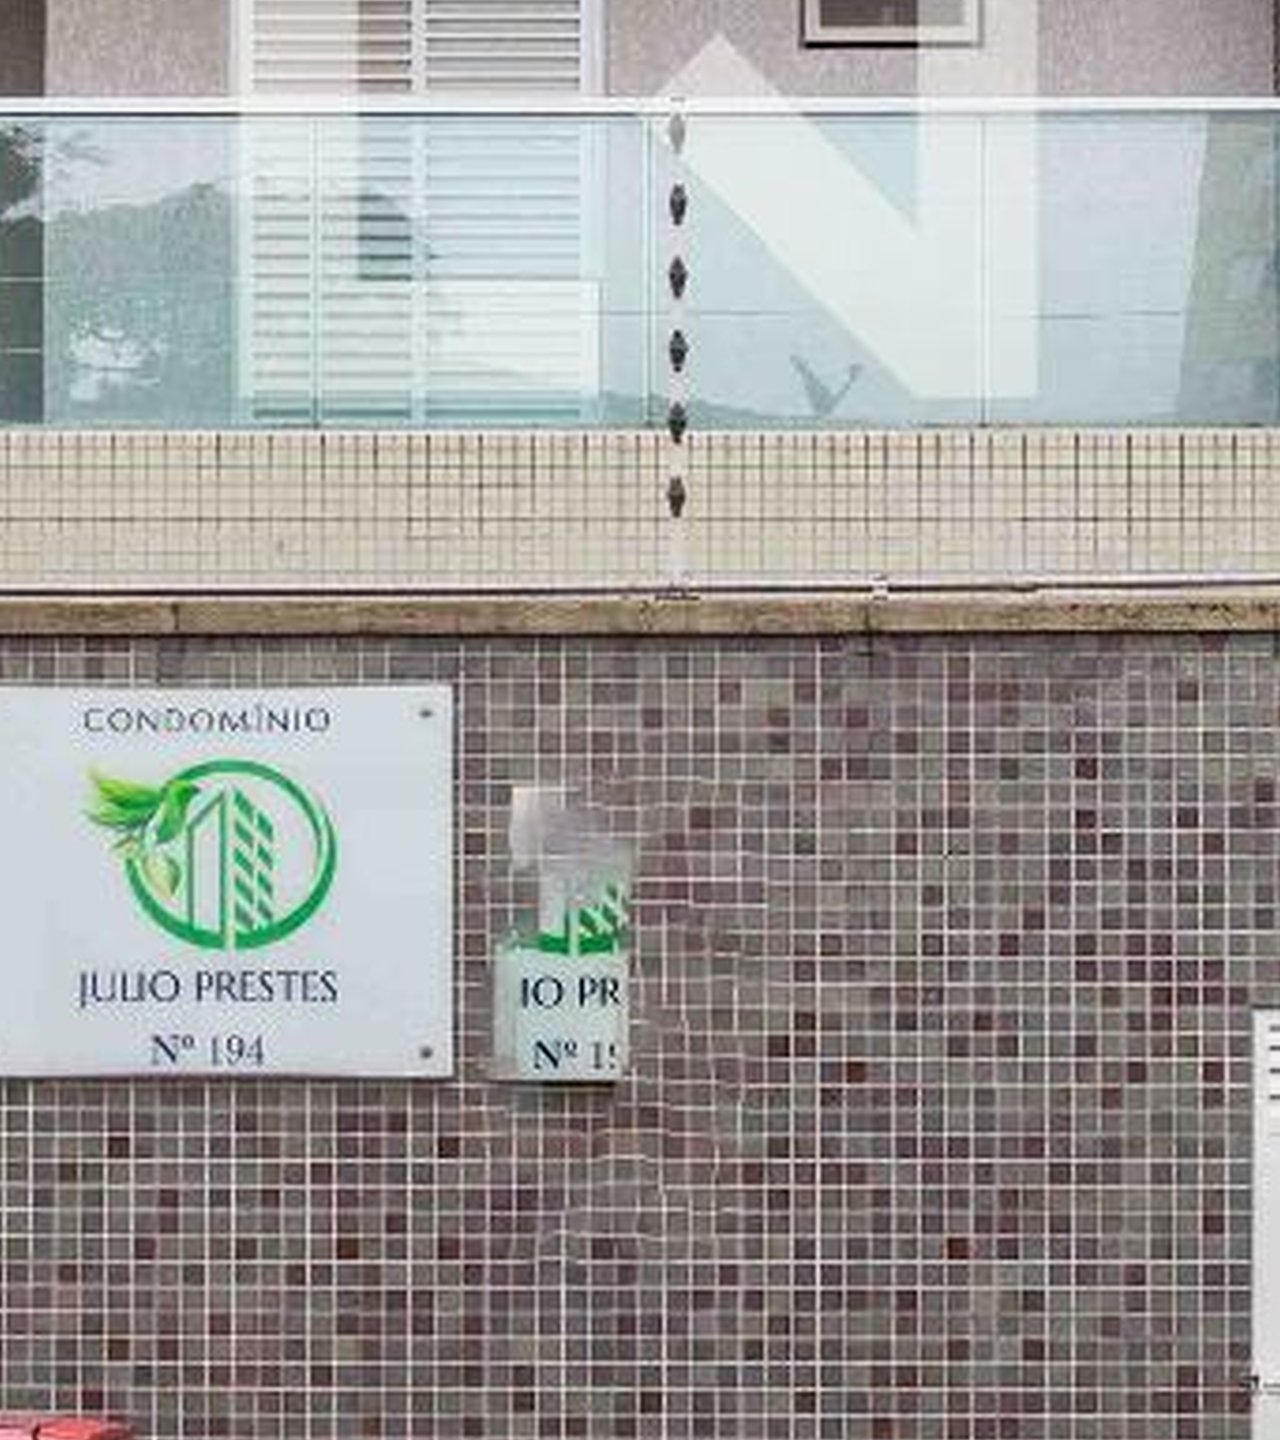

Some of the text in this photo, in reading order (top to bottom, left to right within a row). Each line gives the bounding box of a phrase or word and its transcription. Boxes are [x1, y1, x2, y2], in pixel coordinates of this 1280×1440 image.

[83, 702, 332, 733] CONDOMÍNIO
[79, 970, 339, 1008] JULIO PRESTES
[210, 1034, 264, 1067] 194
